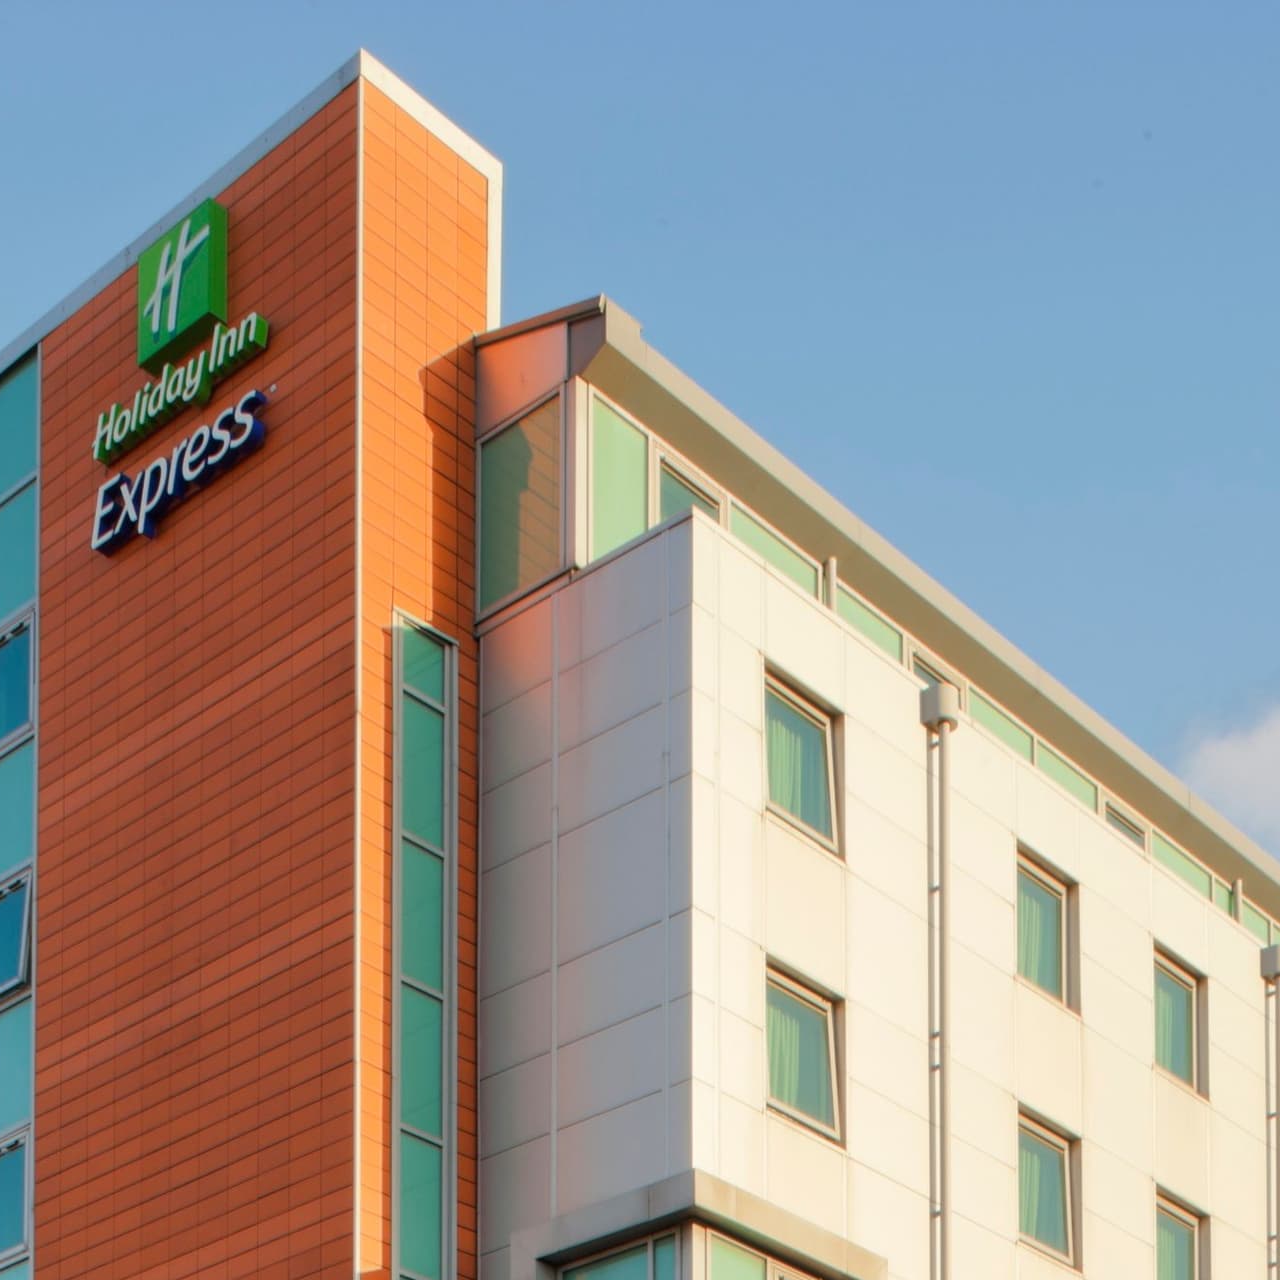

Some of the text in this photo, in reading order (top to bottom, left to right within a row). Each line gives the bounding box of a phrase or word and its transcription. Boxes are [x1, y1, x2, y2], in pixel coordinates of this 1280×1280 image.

[92, 312, 261, 462] Holiday Inn
[91, 389, 262, 551] Express
